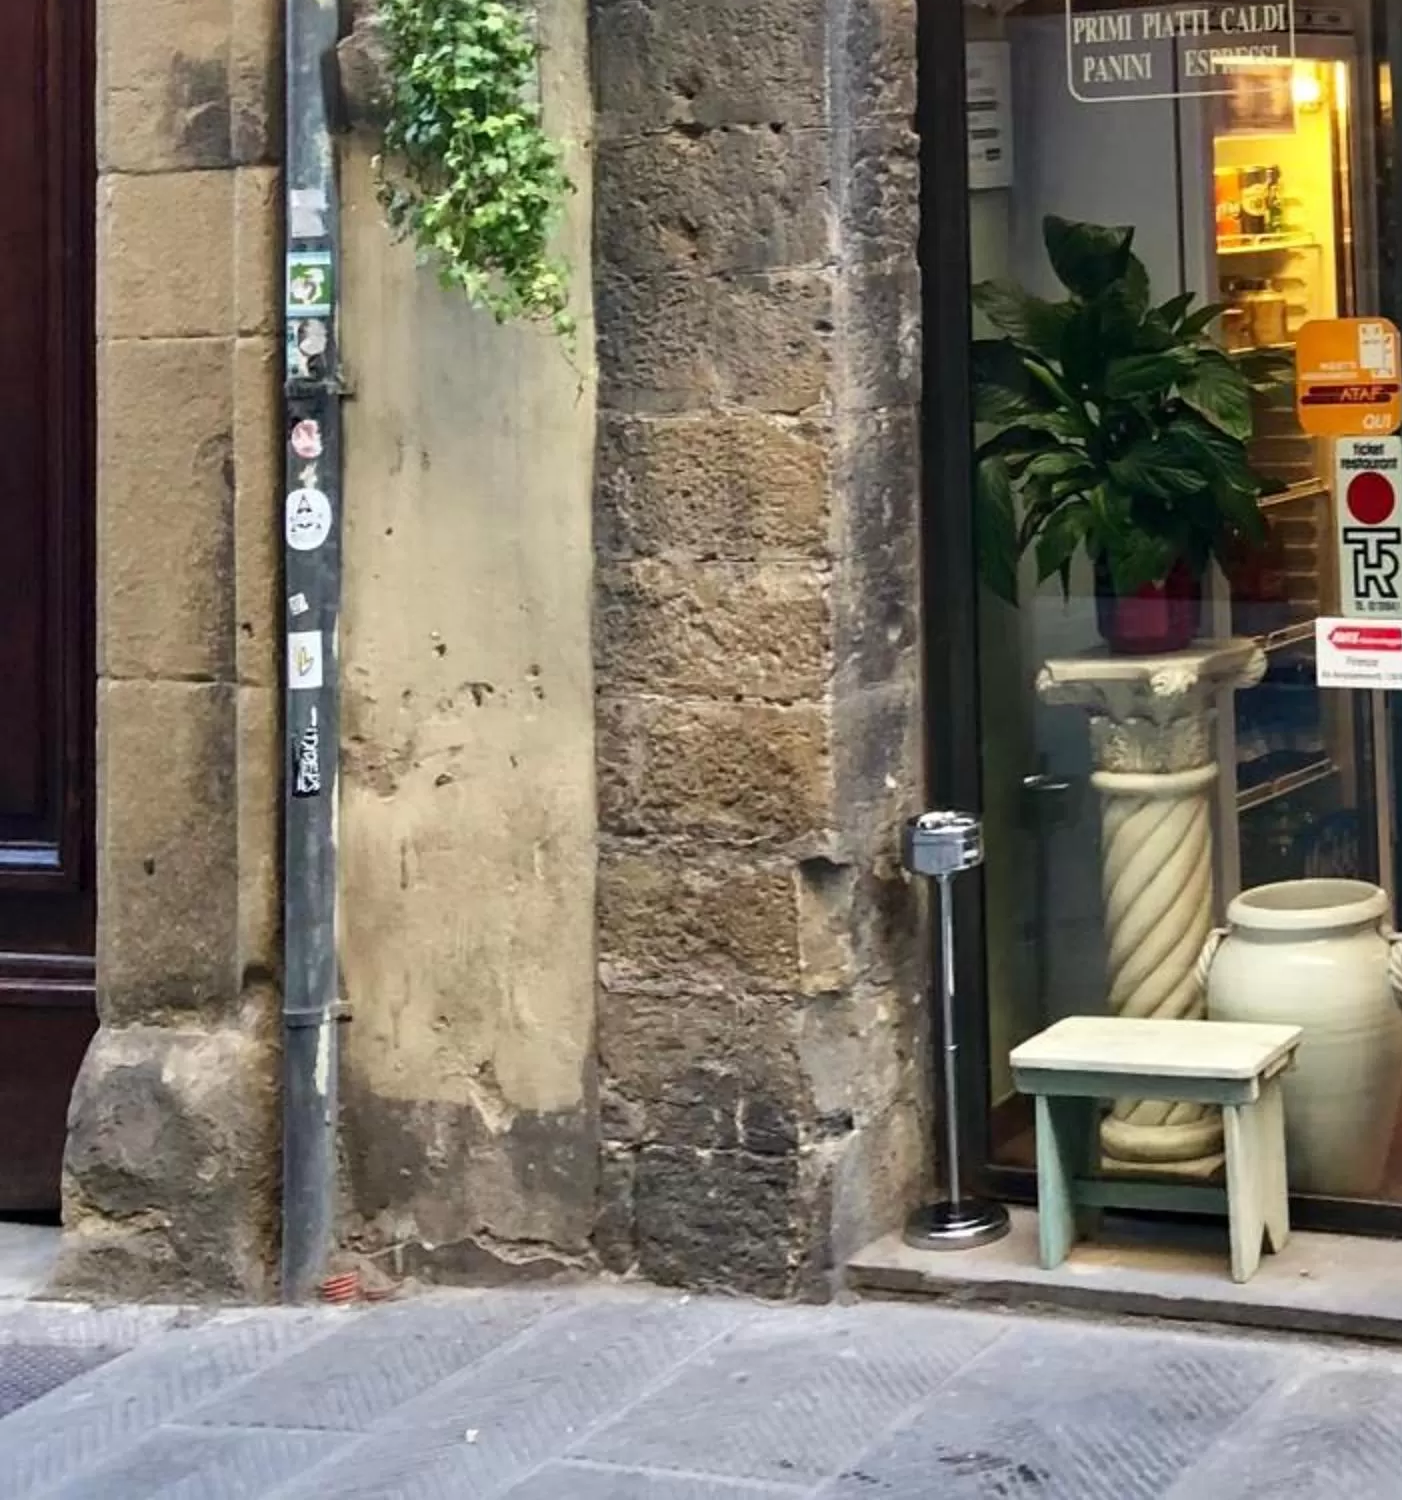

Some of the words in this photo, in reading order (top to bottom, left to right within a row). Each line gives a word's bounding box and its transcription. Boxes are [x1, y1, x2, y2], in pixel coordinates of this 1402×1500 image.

[1073, 13, 1132, 44] PRIMI
[1142, 8, 1211, 39] PIATTI
[1220, 3, 1286, 34] CALDI
[1083, 52, 1152, 83] PANINI
[1340, 385, 1383, 401] ATAF
[1362, 412, 1392, 430] QUI
[1353, 443, 1384, 456] ticket
[1340, 457, 1397, 470] restaurant
